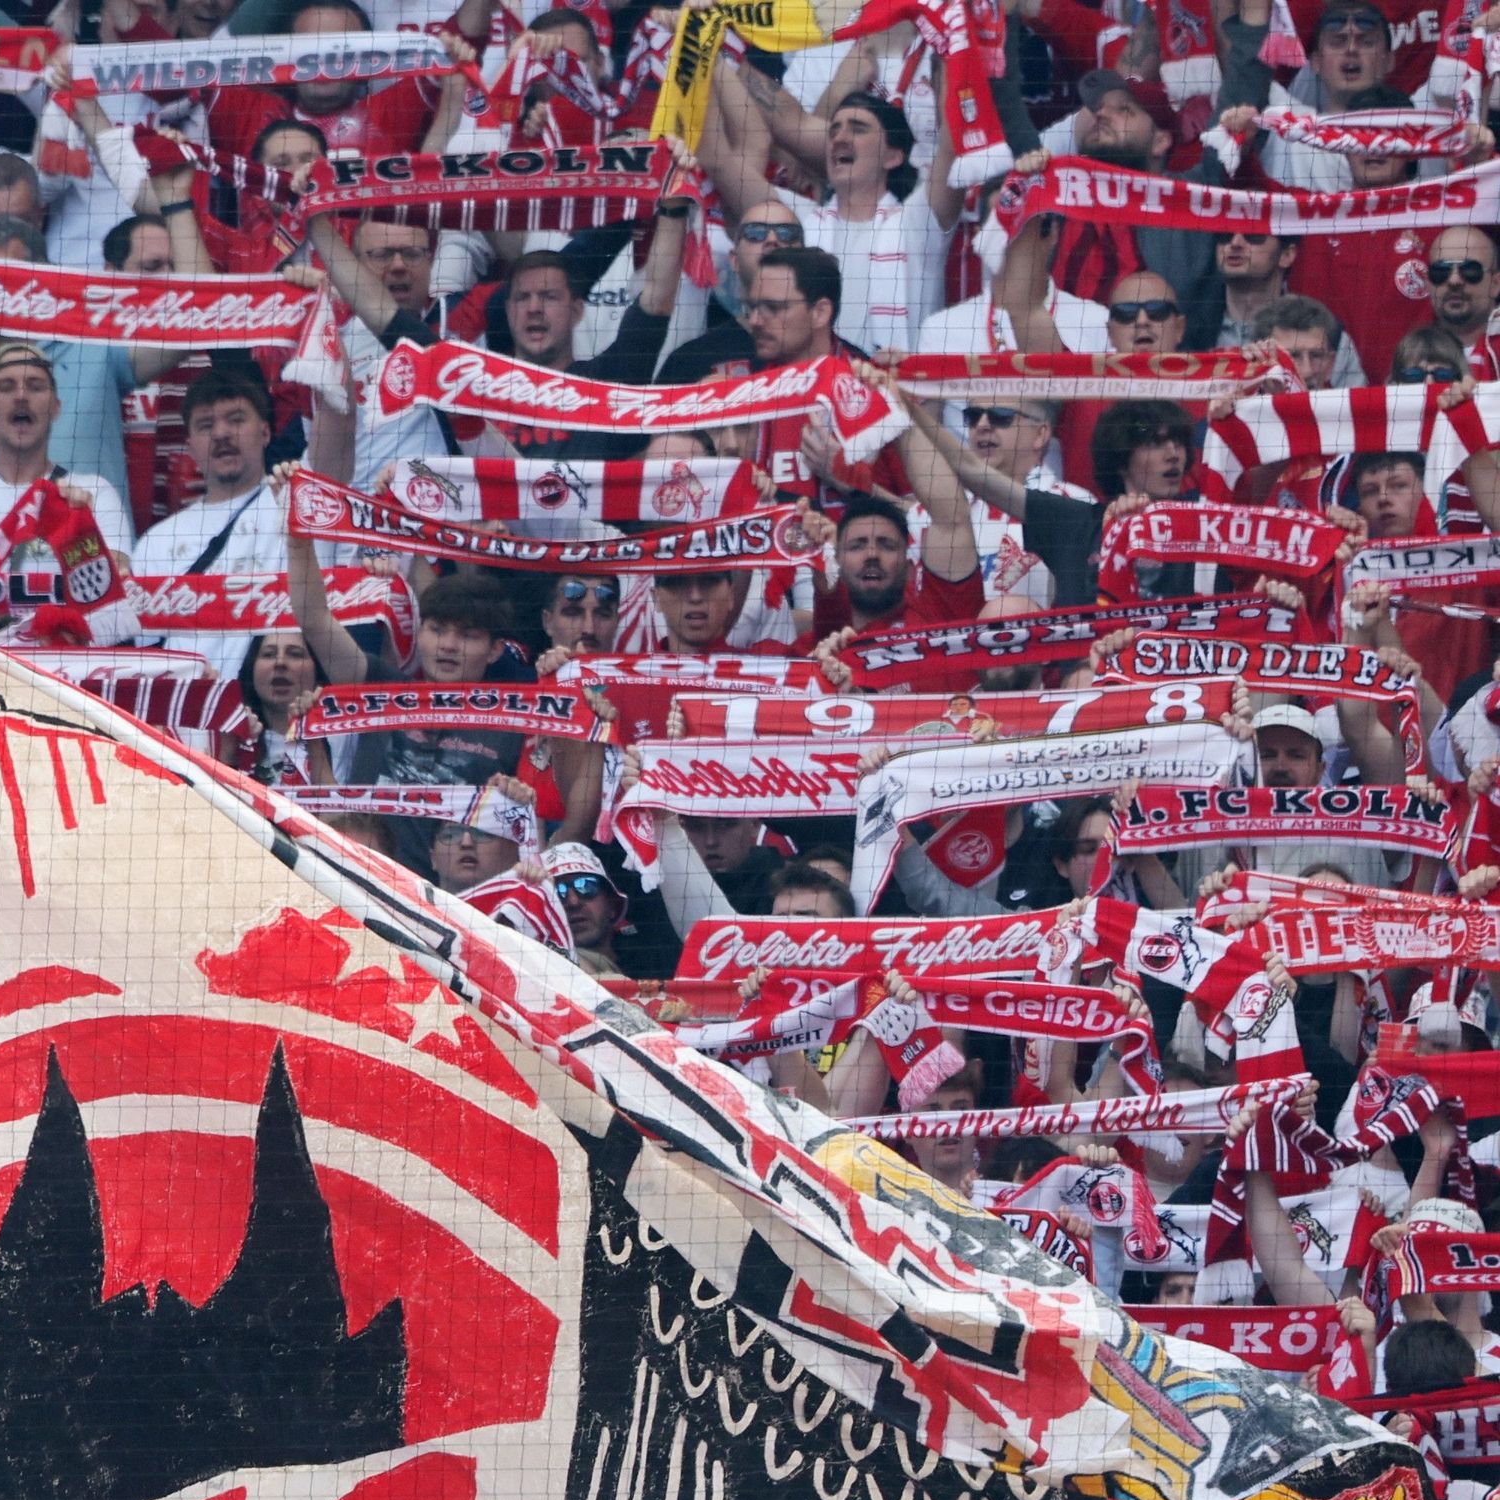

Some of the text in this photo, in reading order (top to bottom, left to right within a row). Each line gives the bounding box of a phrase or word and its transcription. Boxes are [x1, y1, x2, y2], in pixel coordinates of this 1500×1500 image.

[94, 57, 276, 92] WILDER
[295, 46, 453, 81] SÜDEN
[331, 157, 413, 186] FC
[1055, 168, 1174, 208] RUT
[1295, 177, 1479, 219] WIESS
[653, 516, 774, 562] FANS
[1200, 511, 1315, 553] KÖLN
[856, 622, 1097, 670] KÖLN
[1135, 638, 1346, 681] SIND DIE
[322, 686, 577, 719] 1. FC KÖLN
[933, 760, 1221, 799] BORUSSIA DORTMUND
[1128, 794, 1167, 828] 1.
[1180, 788, 1248, 819] FC
[1209, 818, 1362, 831] DIE MACHT AM RHEIN
[701, 925, 864, 980] Geliebter
[1089, 1097, 1187, 1135] Köln
[1230, 1310, 1341, 1354] KÖL
